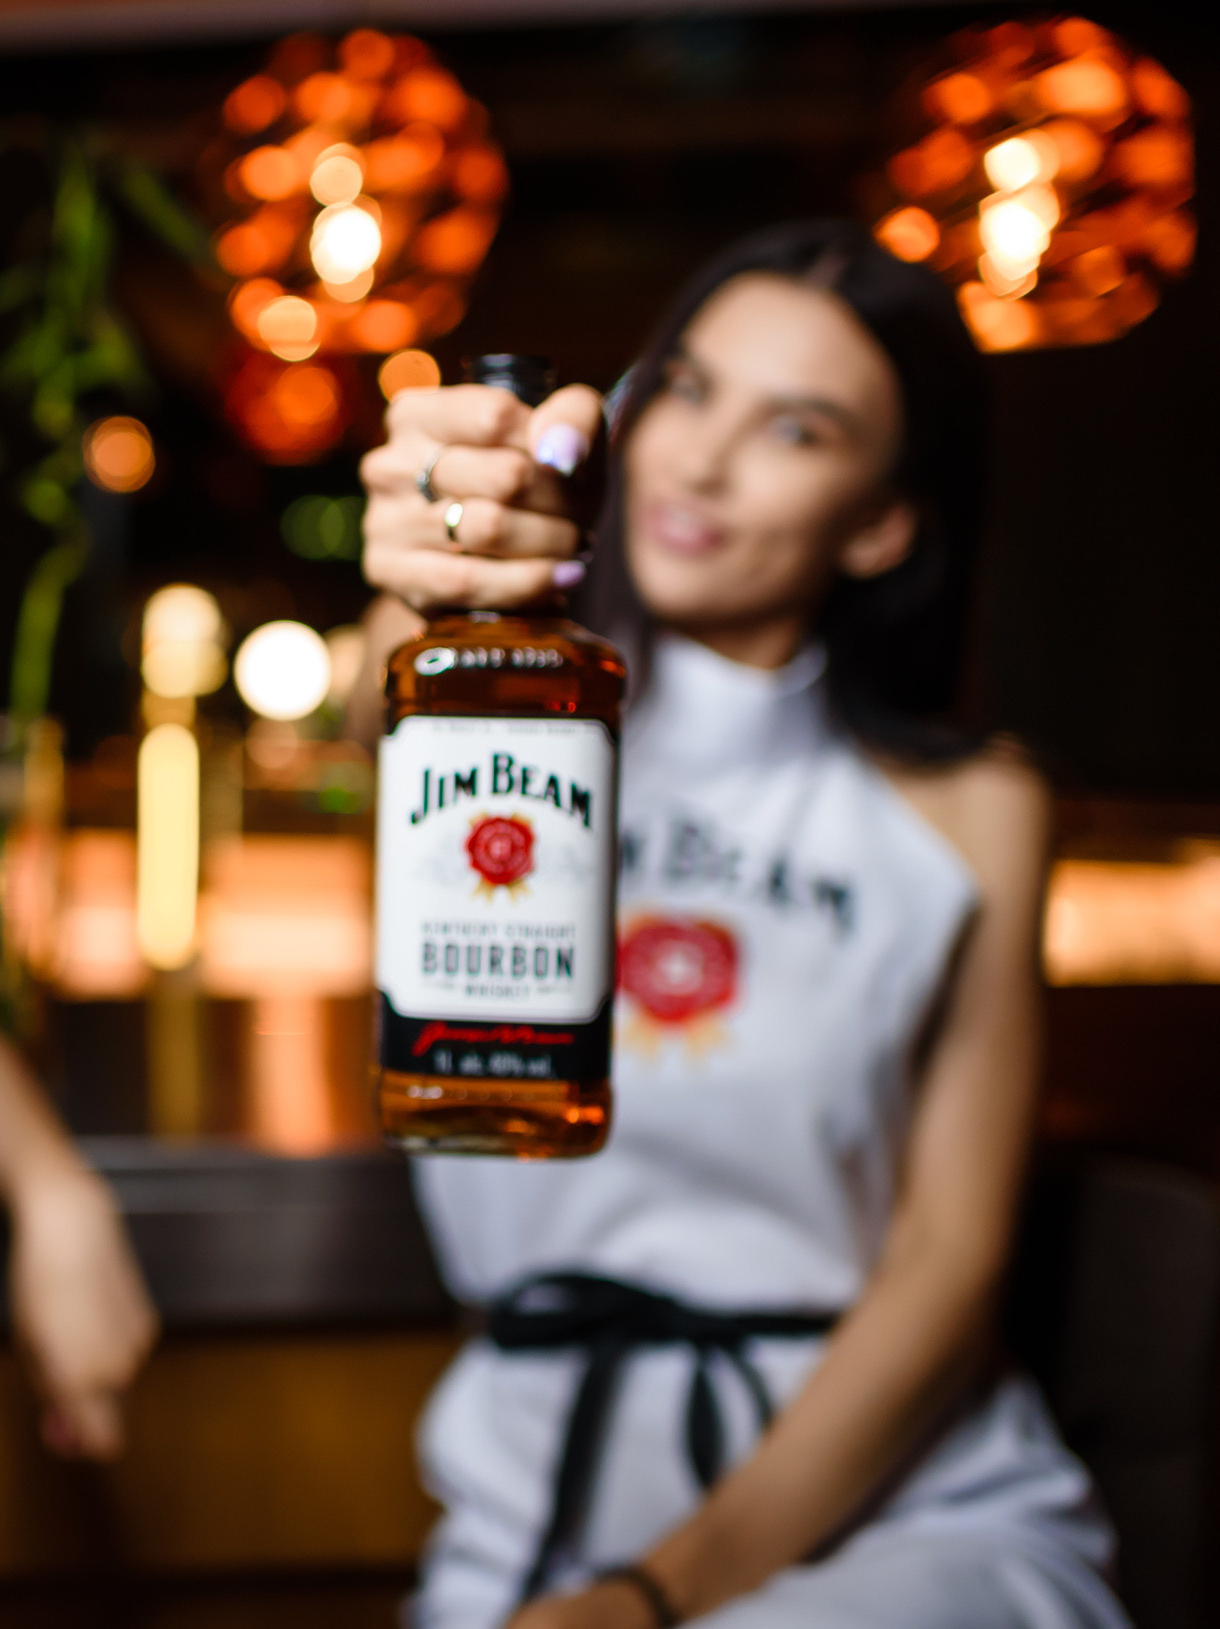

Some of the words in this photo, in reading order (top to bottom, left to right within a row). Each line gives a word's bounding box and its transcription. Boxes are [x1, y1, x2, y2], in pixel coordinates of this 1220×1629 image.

[410, 766, 477, 825] JIM
[491, 752, 592, 829] BEAM
[422, 941, 574, 979] BOURBON
